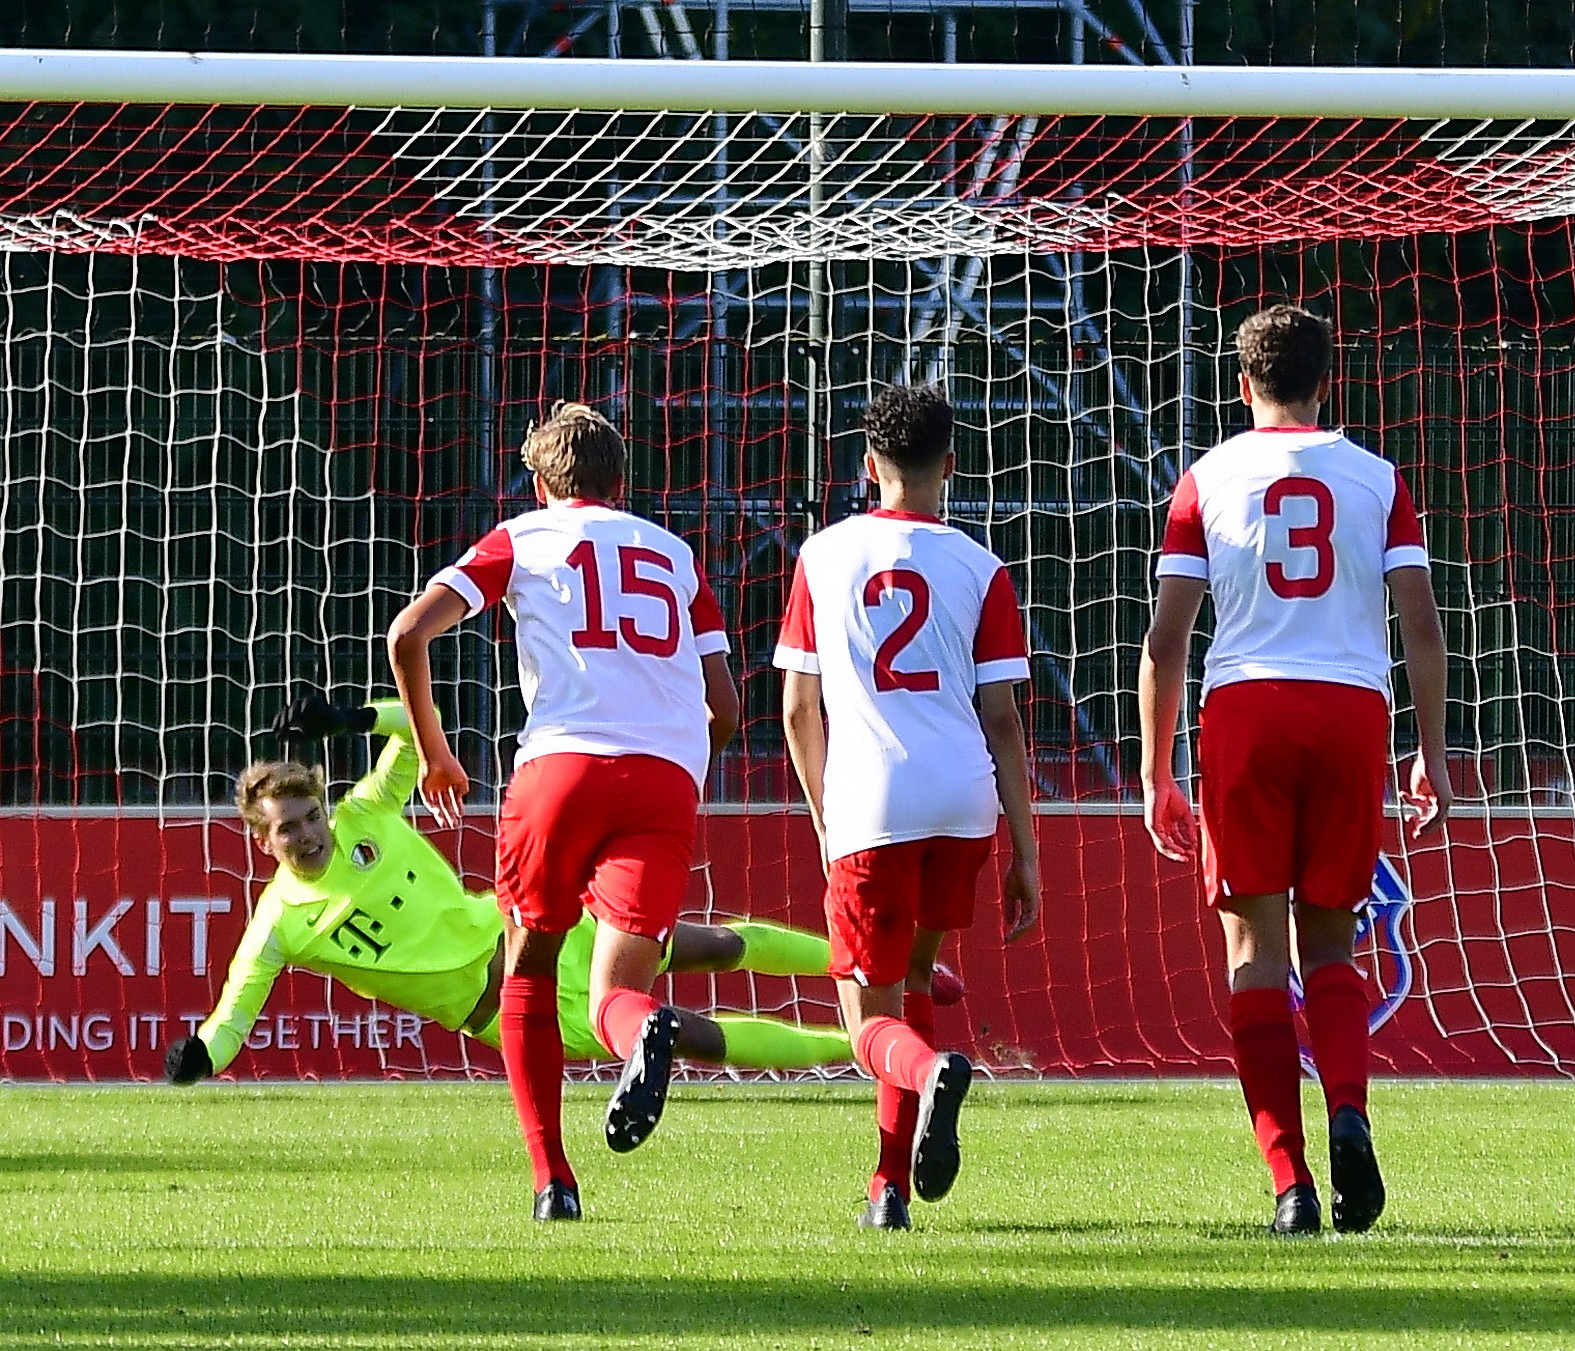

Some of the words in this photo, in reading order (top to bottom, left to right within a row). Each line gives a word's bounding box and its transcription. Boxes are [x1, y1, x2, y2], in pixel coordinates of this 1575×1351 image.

[1263, 476, 1335, 599] 3
[565, 540, 681, 658] 15
[864, 569, 940, 692] 2
[0, 899, 231, 977] NKIT
[3, 1015, 113, 1051] DING
[130, 1016, 167, 1050] IT
[180, 1015, 422, 1050] TGETHER
